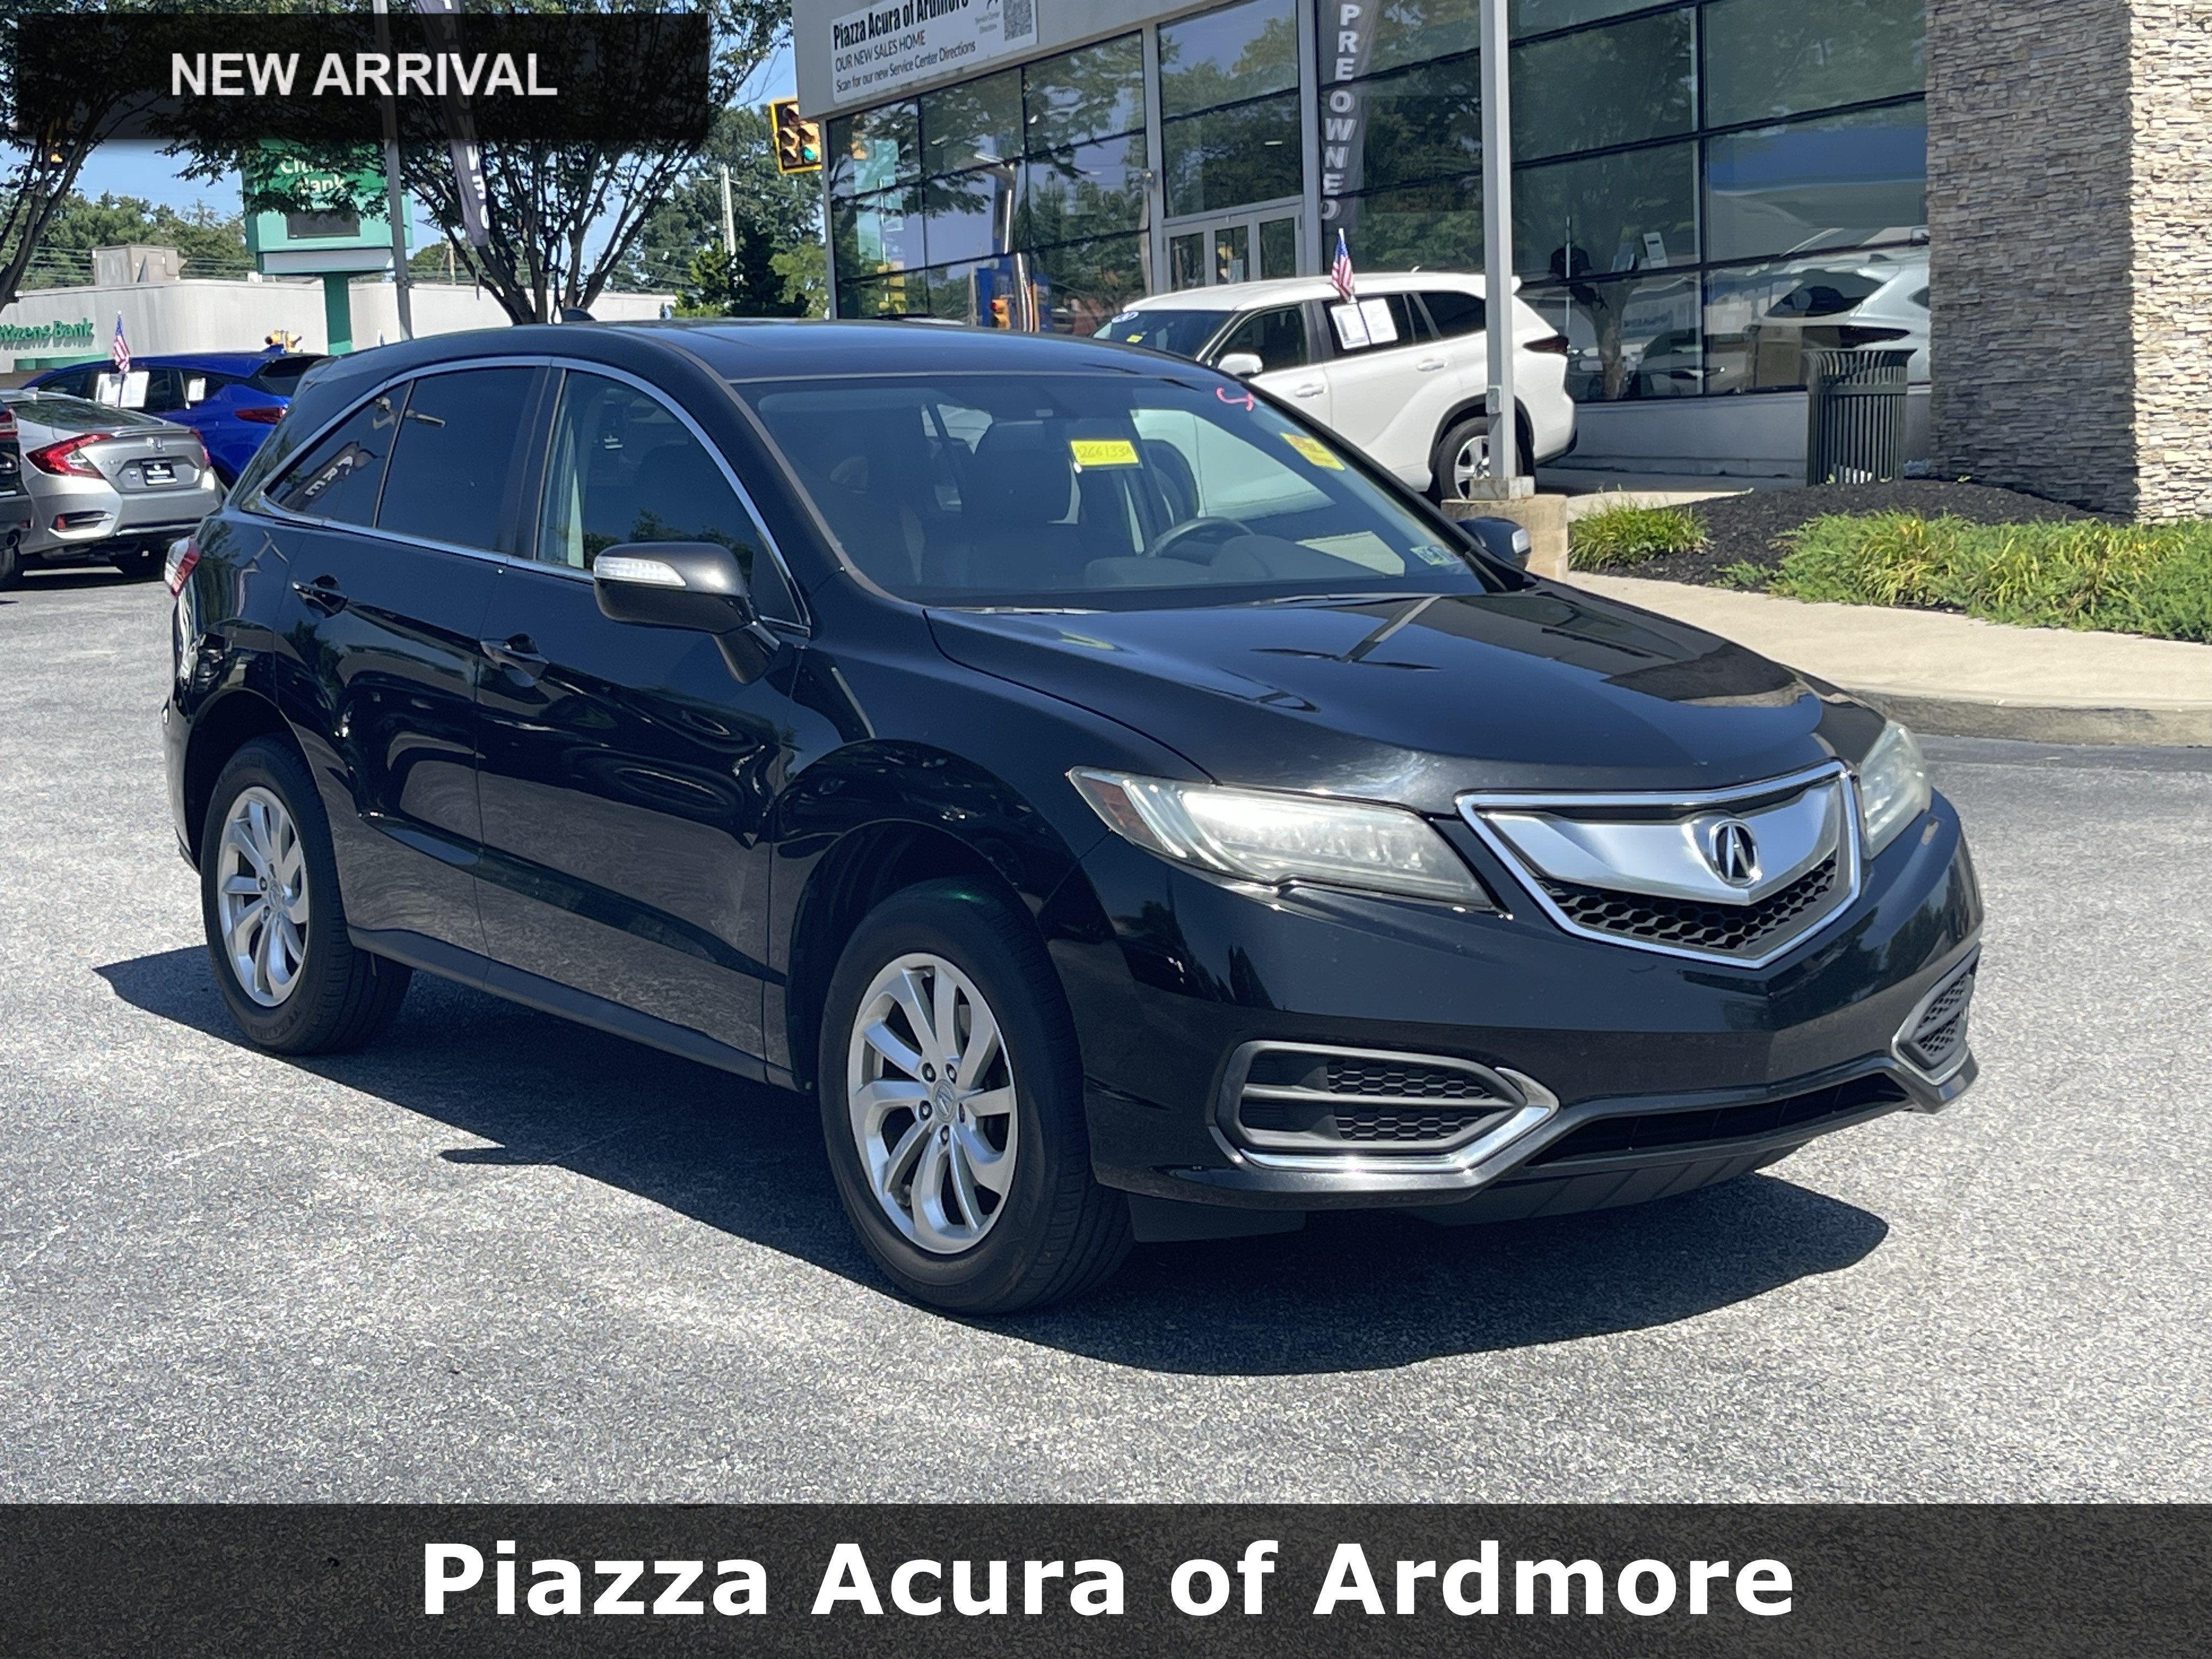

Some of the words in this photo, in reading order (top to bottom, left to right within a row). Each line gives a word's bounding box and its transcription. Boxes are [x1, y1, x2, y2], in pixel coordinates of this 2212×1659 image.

[833, 20, 866, 50] Piazza
[868, 8, 901, 40] Acura
[903, 0, 914, 27] of
[836, 54, 853, 73] OUR
[854, 48, 873, 66] NEW
[874, 40, 898, 60] SALES
[899, 30, 926, 53] HOME
[837, 79, 851, 93] Scan
[852, 75, 861, 87] for
[890, 58, 913, 77] Service
[915, 53, 938, 69] Center
[939, 41, 975, 61] Directions
[53, 317, 94, 338] Bank
